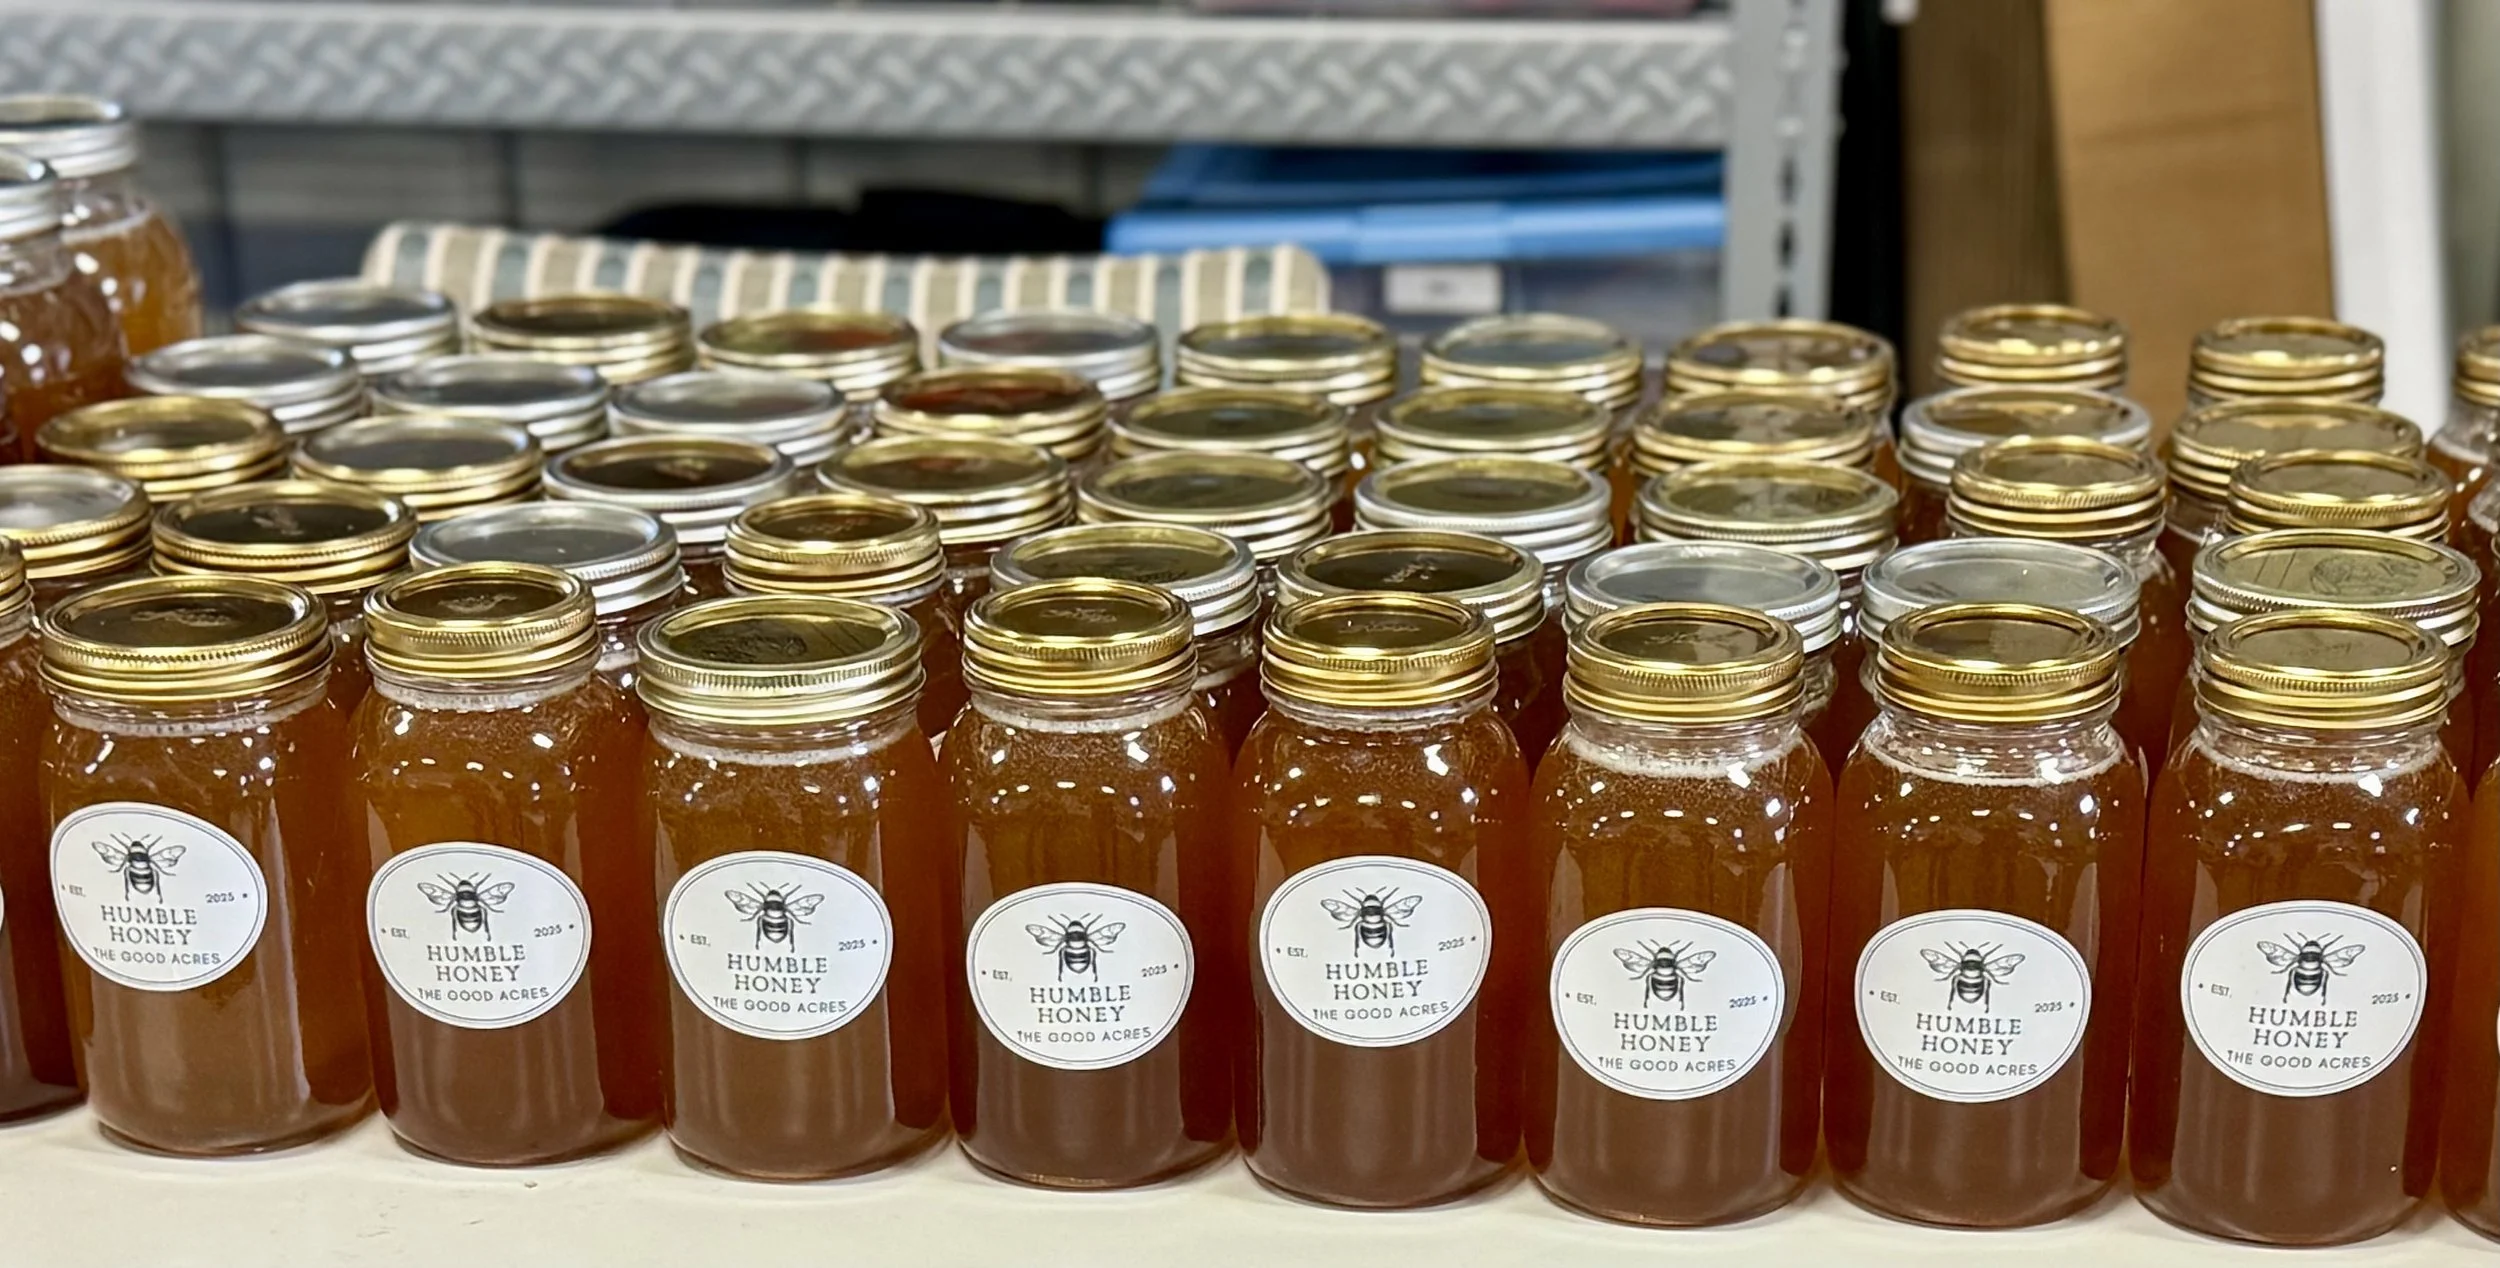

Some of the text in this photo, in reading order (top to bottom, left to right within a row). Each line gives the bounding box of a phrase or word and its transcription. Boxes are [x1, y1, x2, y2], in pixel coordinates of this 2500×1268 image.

[69, 884, 235, 904] EST. 2025
[101, 905, 198, 926] HUMBLE
[111, 926, 192, 946] HONEY
[391, 925, 562, 939] EST. 2025
[691, 934, 866, 951] EST. 2025
[1288, 946, 1308, 958] EST.
[94, 947, 221, 965] THE GOOD ACRES
[427, 944, 526, 962] HUMBLE
[728, 953, 828, 973] HUMBLE
[1326, 959, 1429, 980] HUMBLE
[437, 965, 520, 983] HONEY
[735, 973, 822, 994] HONEY
[992, 969, 1012, 981] EST.
[418, 987, 549, 1001] THE GOOD ACRES
[1030, 985, 1131, 1003] HUMBLE
[1334, 980, 1423, 1000] HONEY
[1577, 993, 1597, 1006] EST.
[2211, 984, 2399, 1005] EST. 2025
[714, 997, 847, 1013] THE GOOD ACRES
[1313, 1001, 1449, 1021] THE GOOD ACRES
[1881, 990, 2063, 1013] EST. 2025
[1038, 1005, 1126, 1023] HONEY
[1614, 1013, 1718, 1032] HUMBLE
[2249, 1007, 2358, 1028] HUMBLE
[1916, 1013, 2022, 1036] HUMBLE
[1017, 1027, 1152, 1042] THE GOOD ACRES
[1621, 1035, 1711, 1053] HONEY
[2253, 1028, 2349, 1049] HONEY
[1921, 1035, 2014, 1055] HONEY
[1599, 1057, 1735, 1072] THE GOOD ACRES
[1898, 1055, 2038, 1076] THE GOOD ACRES
[2227, 1050, 2371, 1069] THE GOOD ACRES
